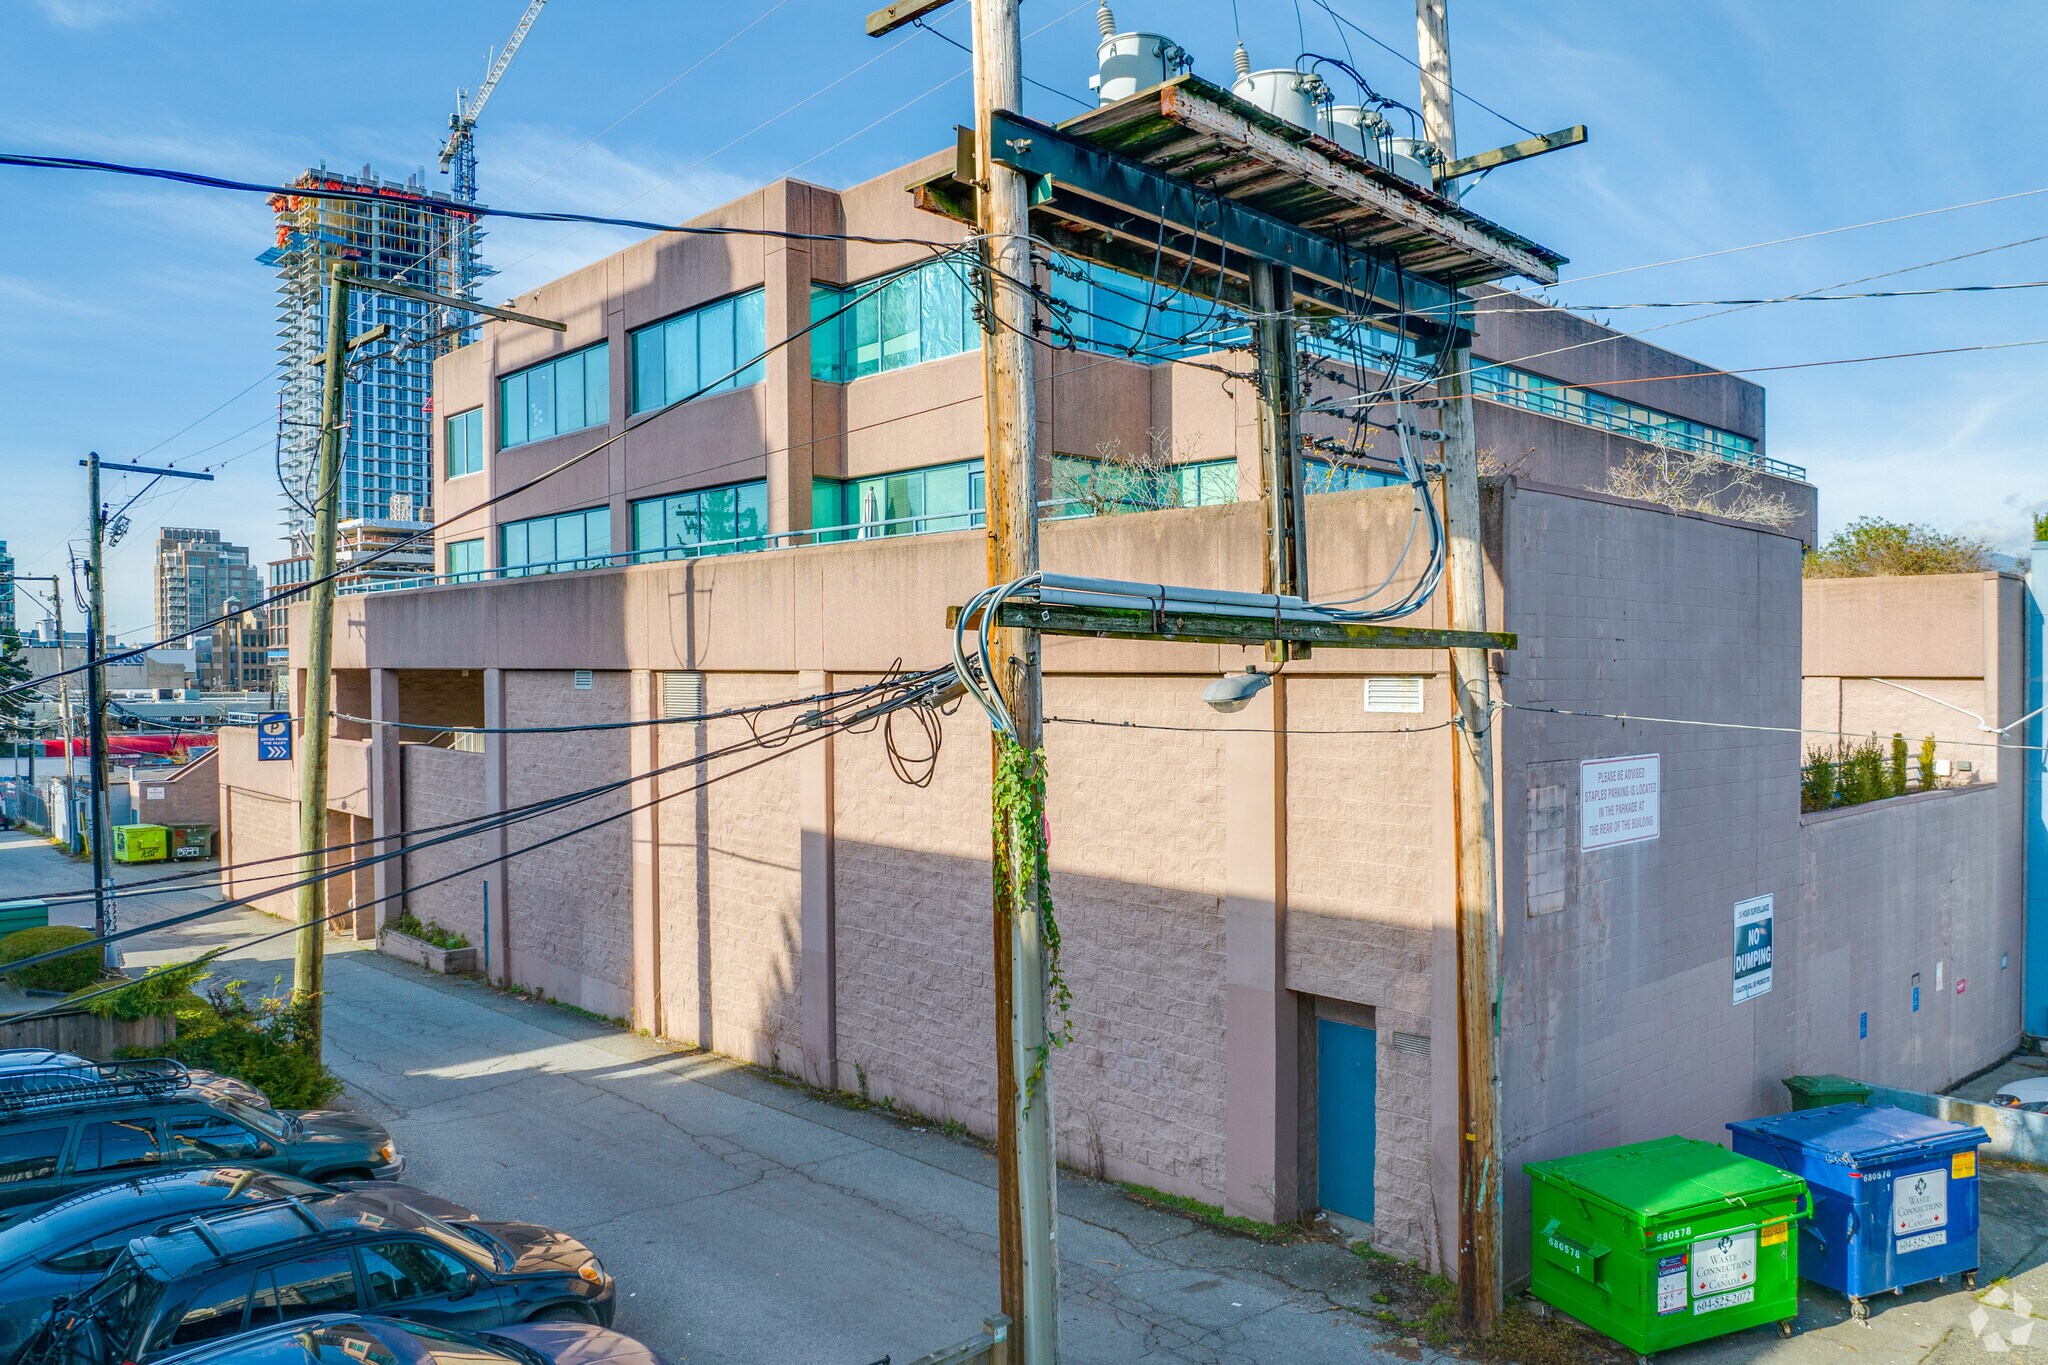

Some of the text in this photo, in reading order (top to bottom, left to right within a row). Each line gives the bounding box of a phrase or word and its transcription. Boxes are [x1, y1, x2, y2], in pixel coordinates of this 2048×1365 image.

[270, 722, 279, 733] P
[1598, 767, 1645, 783] PLEASE BE ADVISED
[1585, 782, 1656, 802] STAPLES PARKING IS LOCATED
[1599, 801, 1645, 818] IN THE PARKADE AT
[1589, 816, 1653, 836] THE REAR OF THE BUILDING
[1748, 927, 1760, 946] NO
[1736, 946, 1771, 973] DUMPING
[1863, 1170, 1892, 1182] 680578
[1908, 1196, 1931, 1205] WASTE
[1898, 1202, 1943, 1217] CONNECTIONS
[1908, 1219, 1933, 1228] CANADA
[1657, 1226, 1691, 1242] 680578
[1899, 1234, 1943, 1250] 604-525-2072
[1548, 1236, 1580, 1259] 680578
[1710, 1254, 1738, 1264] WASTE
[1660, 1265, 1686, 1276] CARDBOARD
[1696, 1258, 1752, 1277] CONNECTIONS
[1709, 1278, 1740, 1289] CANADA
[1697, 1290, 1751, 1312] 604-525-2072
